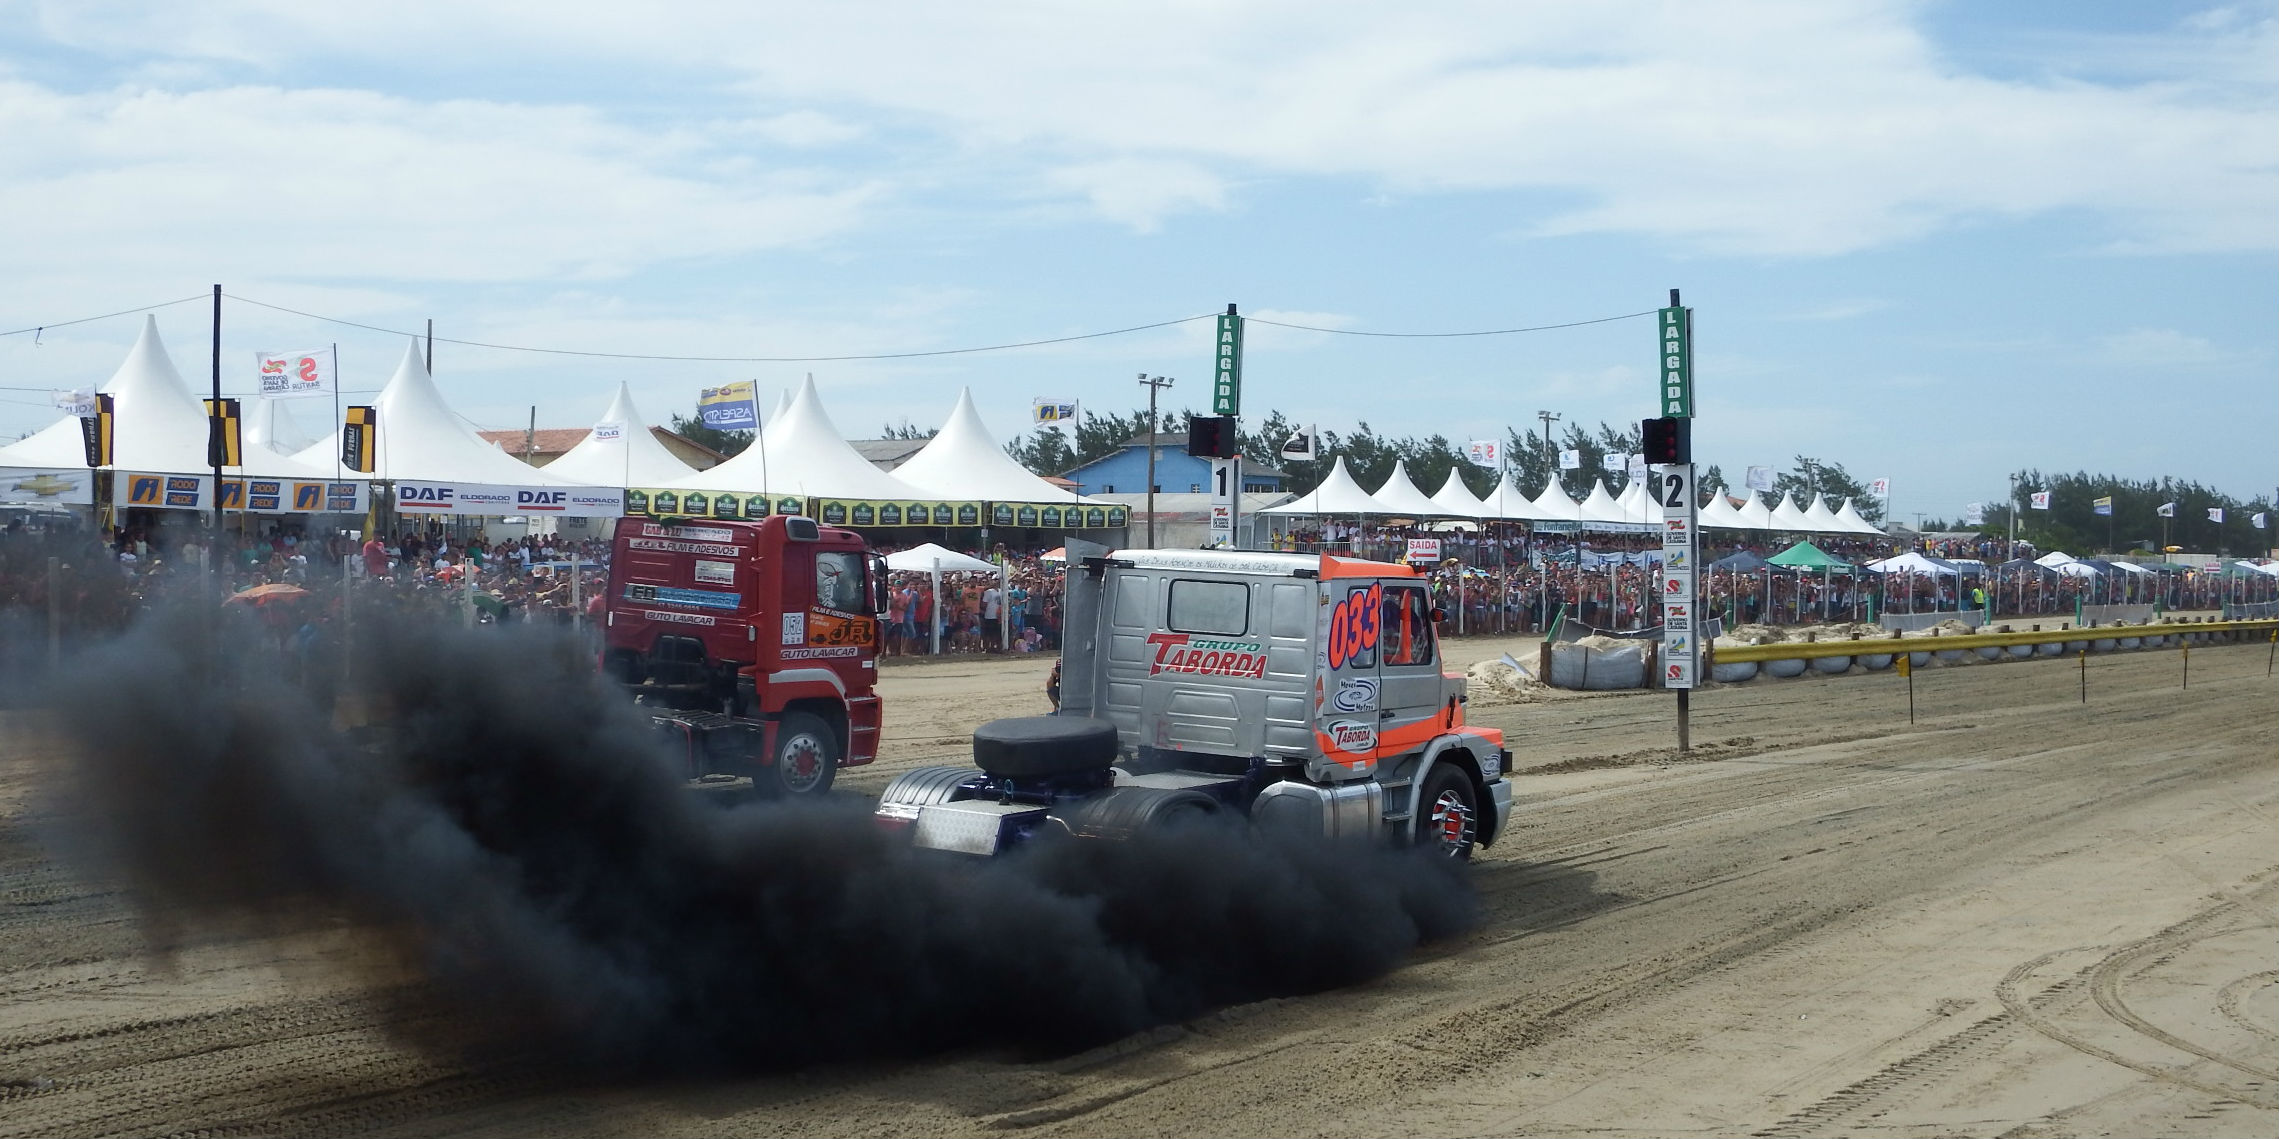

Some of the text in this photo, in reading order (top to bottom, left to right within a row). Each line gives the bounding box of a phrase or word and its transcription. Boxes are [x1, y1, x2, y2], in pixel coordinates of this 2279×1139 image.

[1218, 318, 1232, 410] LARGADA
[1665, 311, 1682, 414] LARGADA
[171, 480, 196, 489] RODO
[253, 484, 278, 493] RODO
[1216, 466, 1227, 497] 1
[400, 486, 454, 501] DAF
[517, 491, 567, 504] DAF
[1666, 474, 1684, 508] 2
[170, 494, 193, 504] REDE
[695, 545, 735, 555] ADESIVOS
[1410, 541, 1437, 549] SAIDA
[647, 612, 713, 625] GUTO LAVACAR
[784, 615, 802, 635] 052
[1328, 582, 1382, 671] 033
[781, 647, 856, 659] GUTO LAVACAR
[1193, 640, 1261, 652] GRUPO
[1147, 633, 1267, 679] TABORDA
[1336, 726, 1370, 745] TABORDA
